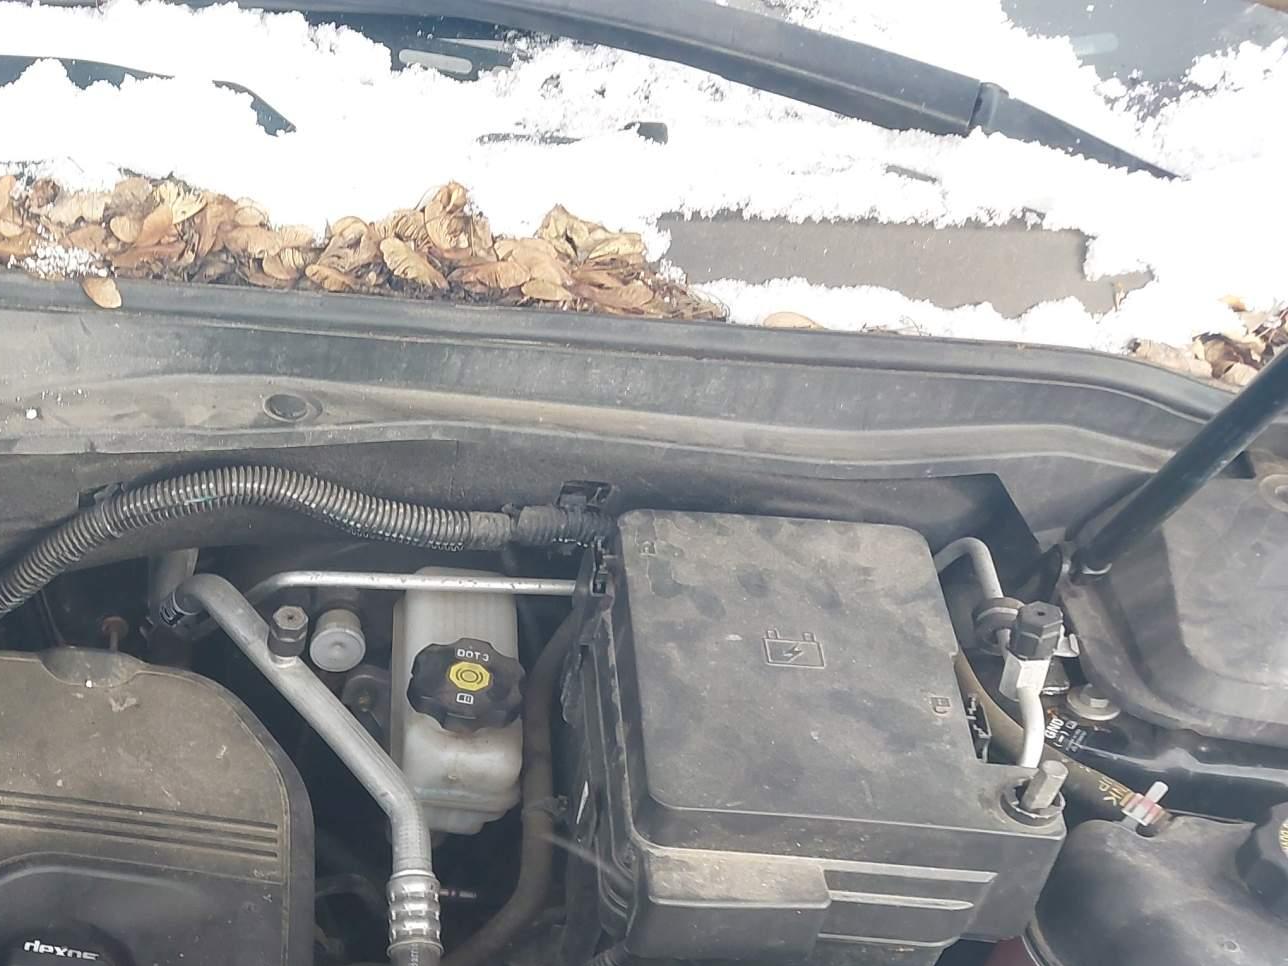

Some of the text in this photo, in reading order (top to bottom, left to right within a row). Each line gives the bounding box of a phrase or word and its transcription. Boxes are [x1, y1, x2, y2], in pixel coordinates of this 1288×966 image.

[457, 649, 489, 662] DOT 3
[1044, 718, 1065, 739] GND
